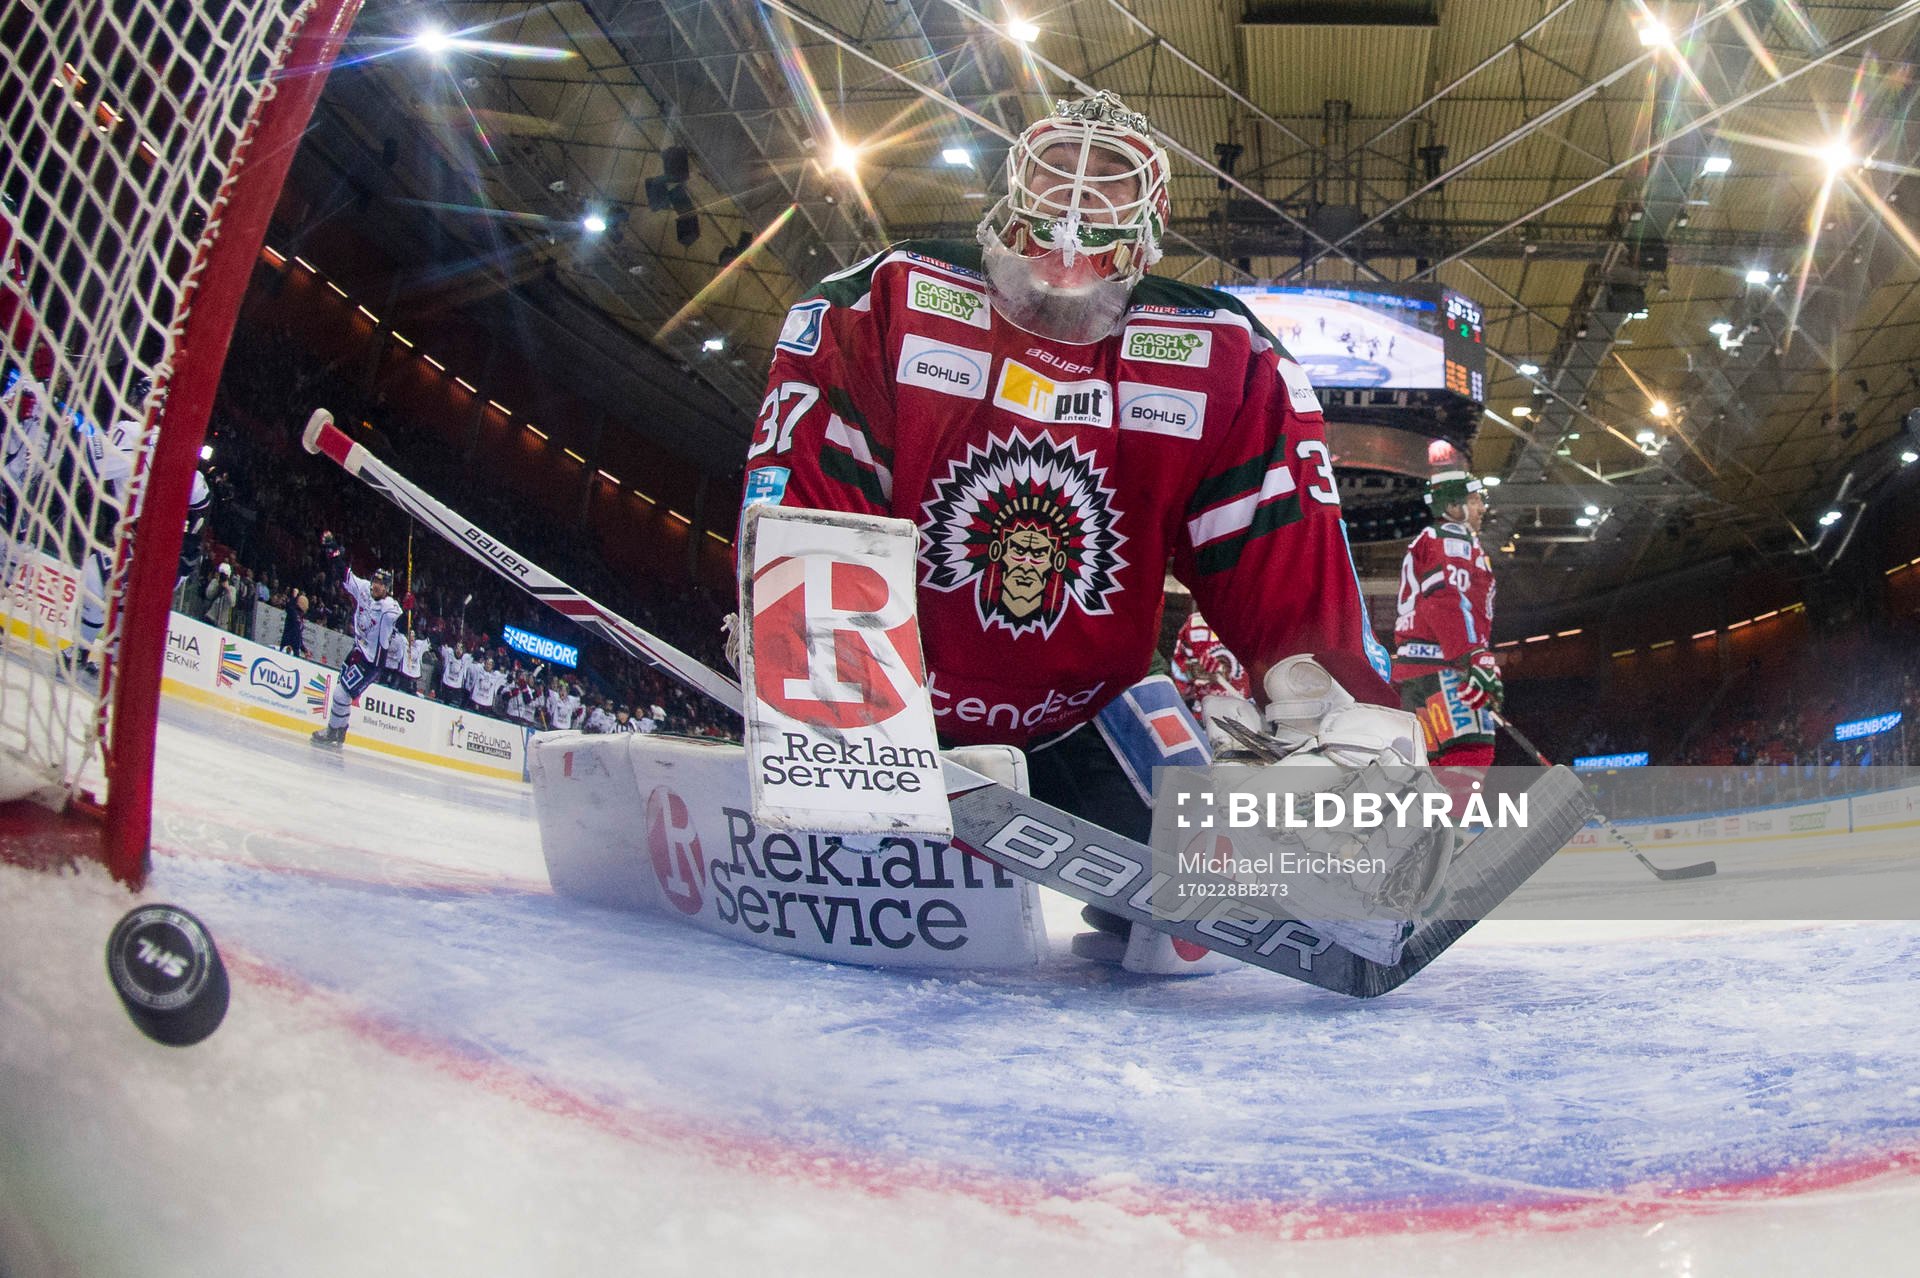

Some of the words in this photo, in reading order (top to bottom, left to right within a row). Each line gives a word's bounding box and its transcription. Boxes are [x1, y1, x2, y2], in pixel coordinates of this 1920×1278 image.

[918, 282, 961, 303] CASH
[917, 293, 973, 320] BUDDY
[1132, 333, 1178, 347] CASH
[1131, 344, 1190, 361] BUDDY
[917, 361, 970, 385] BOHUS
[748, 382, 819, 459] 37
[1064, 414, 1102, 423] interior
[1131, 406, 1186, 425] BOHUS
[1446, 564, 1471, 593] 20
[259, 666, 293, 690] VIDAL
[365, 697, 416, 723] BILLES
[467, 729, 512, 751] FRÖLUNDA
[782, 732, 938, 769] Reklam
[761, 755, 921, 793] Service
[711, 858, 969, 951] Service
